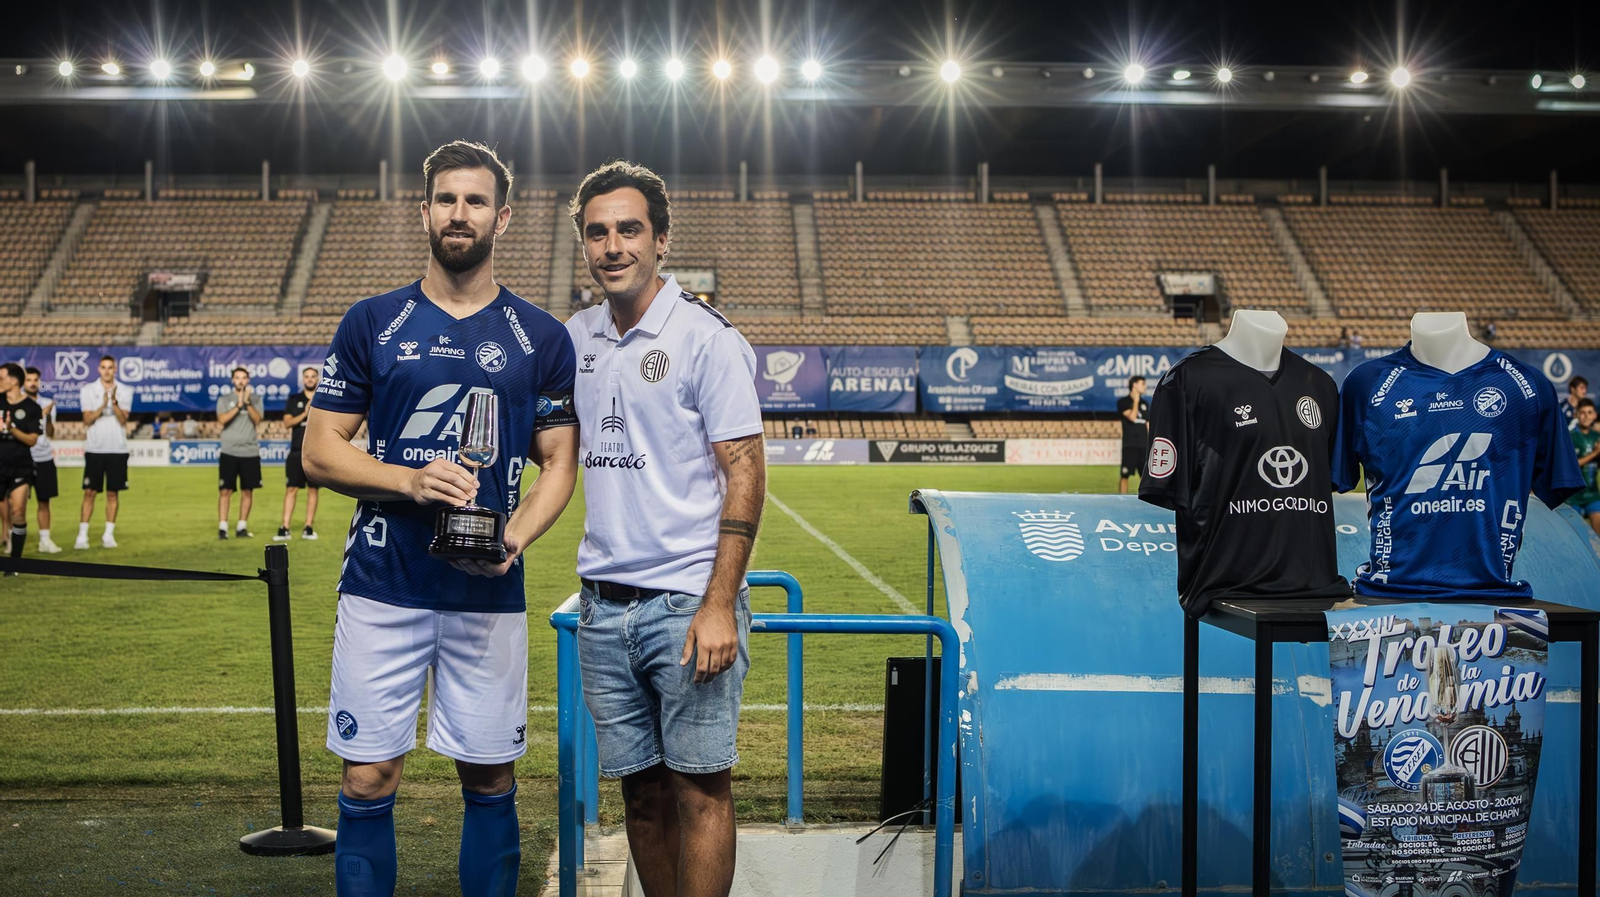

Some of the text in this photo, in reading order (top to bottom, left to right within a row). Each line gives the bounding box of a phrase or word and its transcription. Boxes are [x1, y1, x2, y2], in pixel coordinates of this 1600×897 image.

[429, 346, 465, 356] JIMANG
[830, 366, 915, 377] AUTO-ESCUELA
[830, 378, 915, 392] ARENAL
[1428, 400, 1463, 410] JIMANG
[1235, 417, 1258, 428] hummel
[600, 441, 624, 453] TEATRO
[900, 443, 998, 454] GRUPO VELAZQUEZ
[585, 451, 646, 470] Barceló
[1441, 462, 1491, 491] Air
[1229, 498, 1270, 514] NIMO
[1411, 496, 1486, 515] oneair.es
[1375, 511, 1386, 556] TIENDA
[1382, 496, 1393, 573] INTELIGENTE
[1100, 537, 1177, 556] Depo
[1397, 664, 1481, 692] de la
[1402, 743, 1426, 779] XEREZ
[1395, 780, 1421, 791] DEPO
[1367, 803, 1414, 815] SÁBADO
[1415, 803, 1428, 813] 24
[1430, 803, 1444, 812] DE
[1447, 800, 1488, 811] AGOSTO
[1495, 795, 1523, 807] 20:00H
[1371, 807, 1520, 827] ESTADIO MUNICIPAL DE CHAPÍN
[1402, 834, 1434, 842] TRIBUNA
[1453, 830, 1494, 839] PREFERENCIA
[1346, 840, 1386, 850] Entradas
